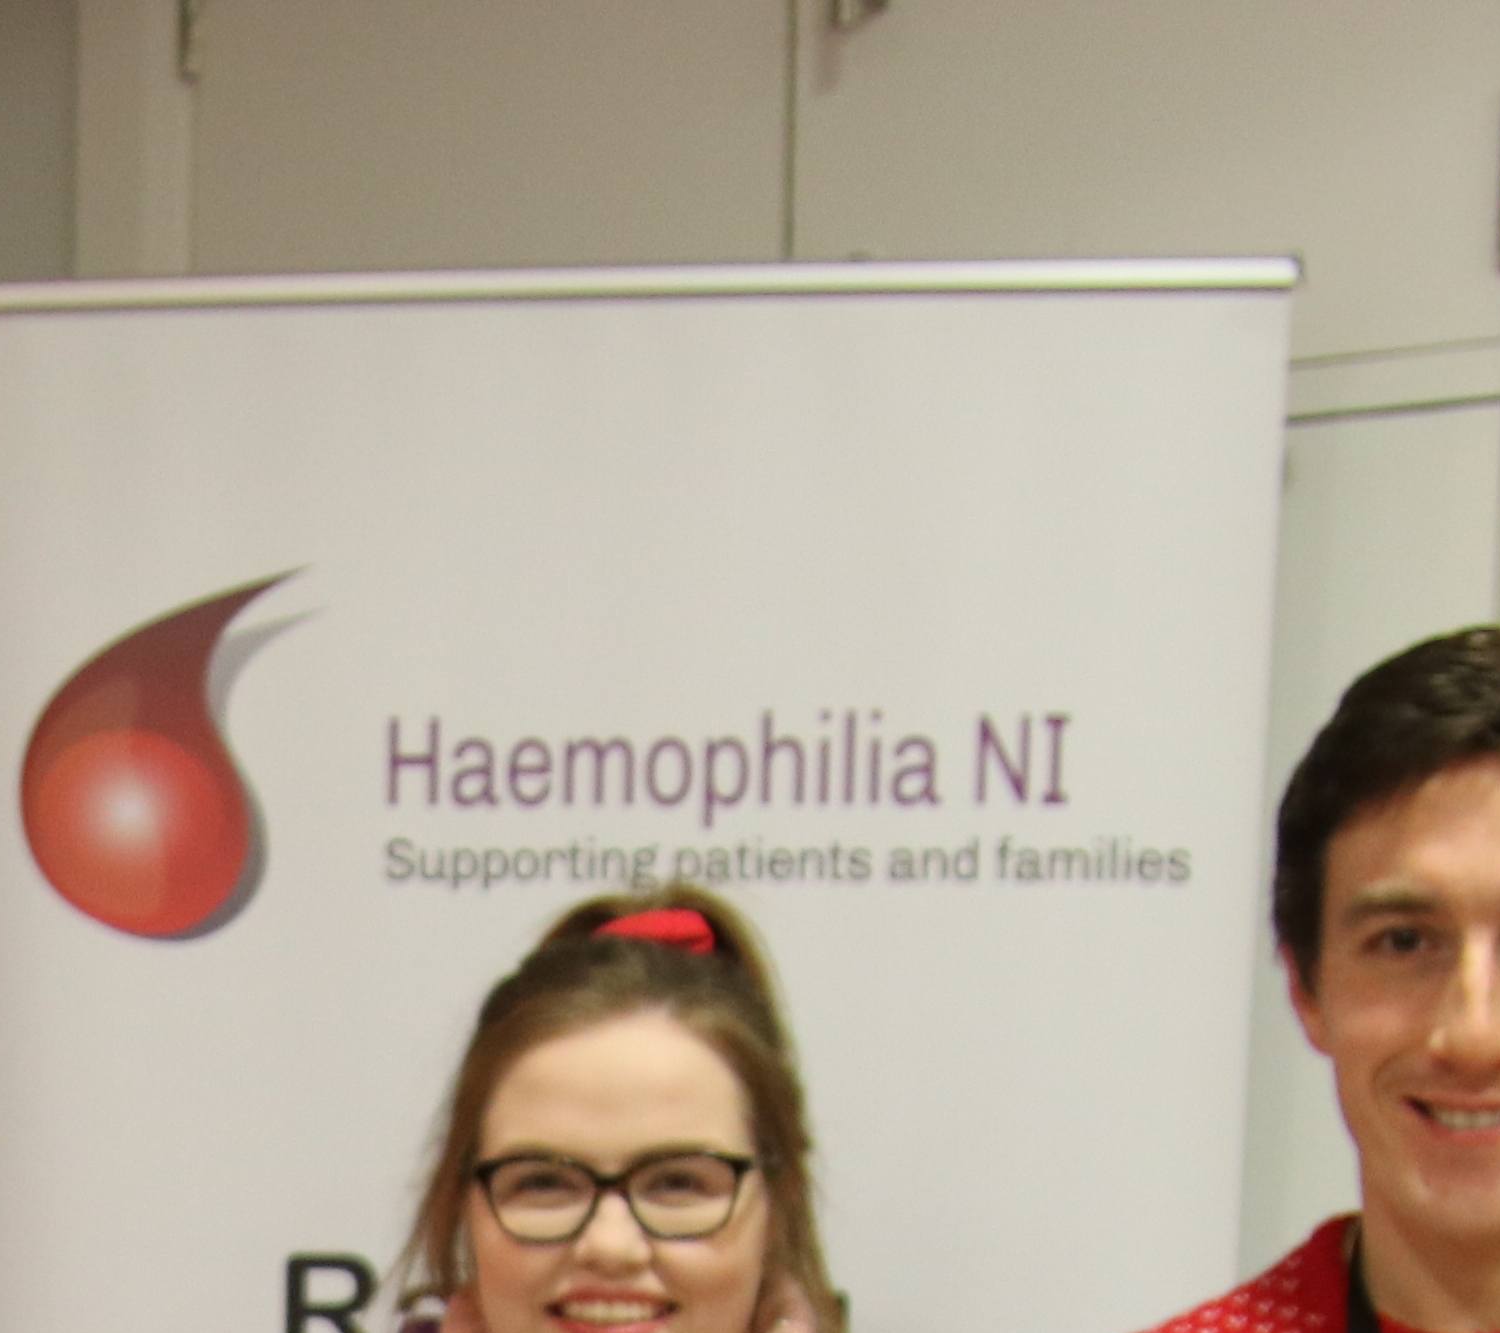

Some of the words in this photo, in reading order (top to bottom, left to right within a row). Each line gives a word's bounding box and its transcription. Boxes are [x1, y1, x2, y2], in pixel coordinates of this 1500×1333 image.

[383, 709, 943, 830] Haemophilia
[972, 711, 1072, 806] NI
[384, 837, 656, 891] Supporting
[673, 839, 873, 888] patients
[887, 838, 980, 883] and
[994, 835, 1193, 884] families
